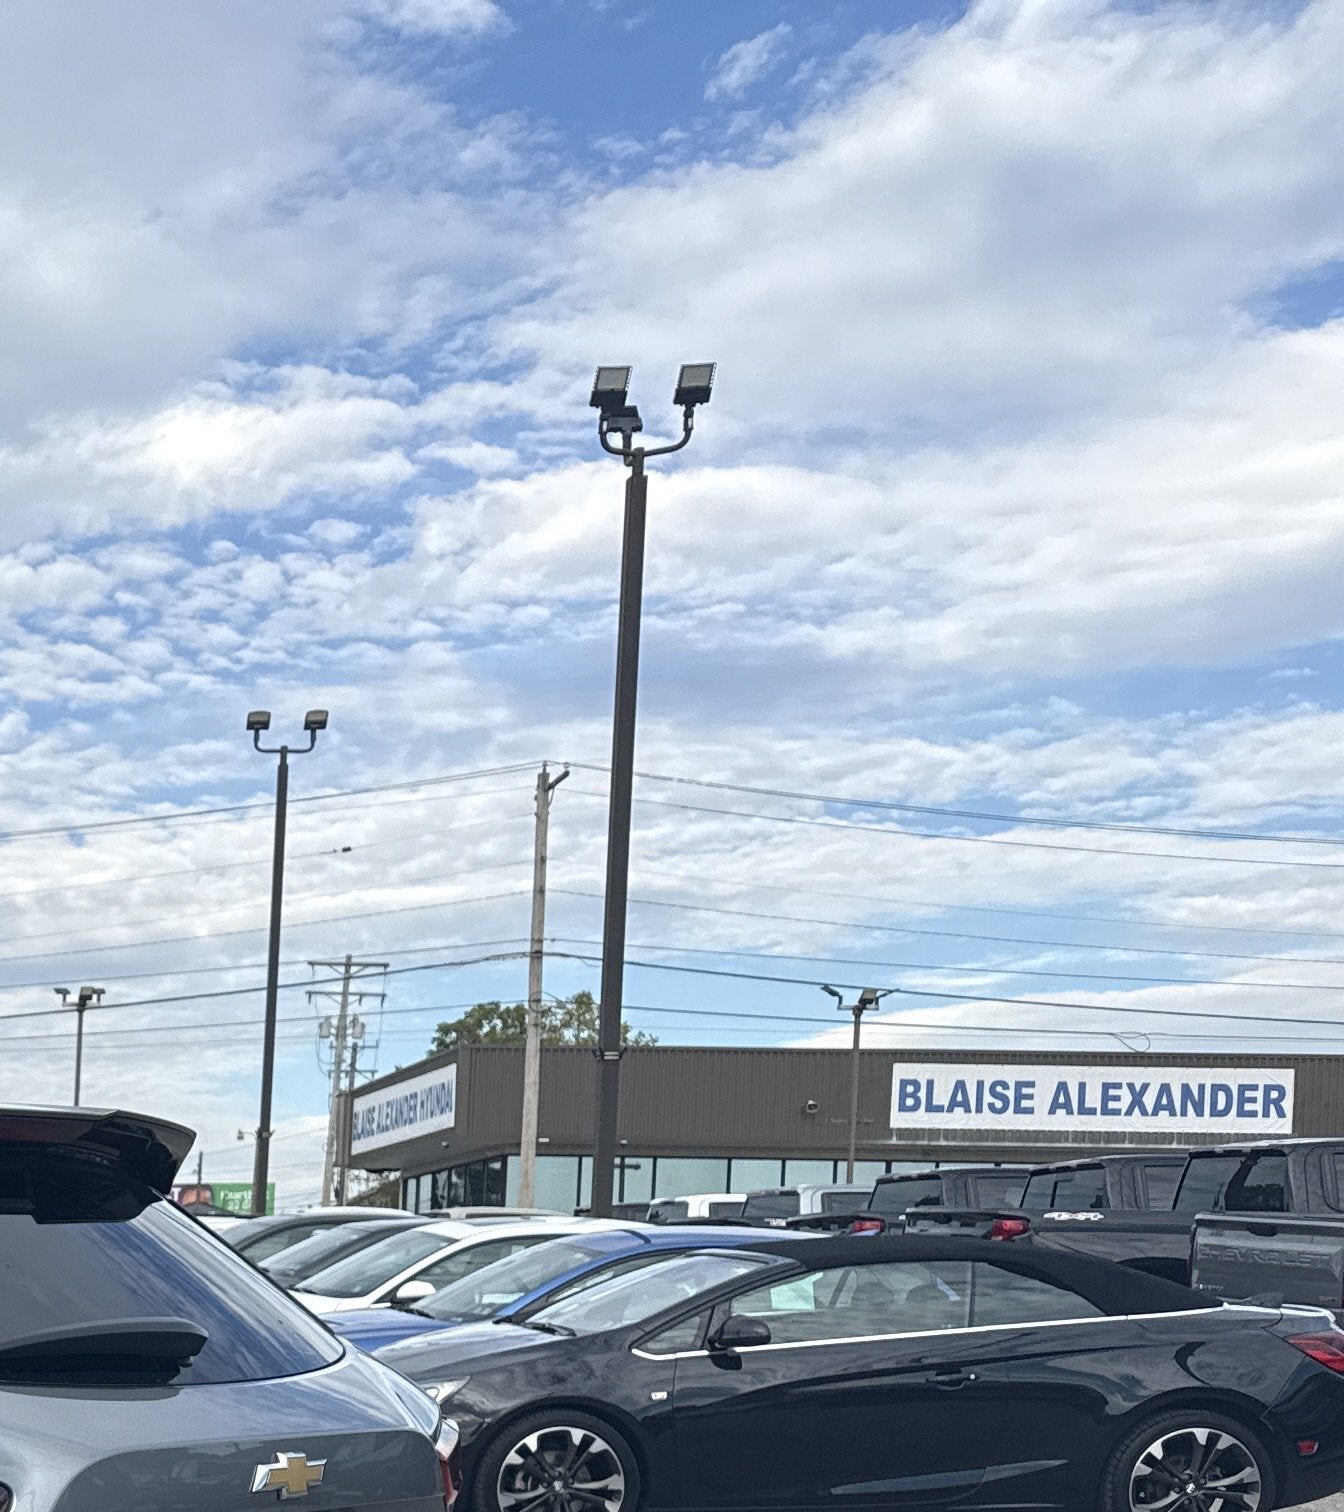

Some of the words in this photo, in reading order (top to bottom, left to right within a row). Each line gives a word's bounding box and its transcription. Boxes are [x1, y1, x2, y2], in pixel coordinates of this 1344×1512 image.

[352, 1105, 375, 1141] BLAISE
[376, 1091, 418, 1134] ALEXANDER
[419, 1079, 453, 1121] HYUNDAI
[898, 1079, 1036, 1114] BLAISE
[1048, 1081, 1287, 1119] ALEXANDER
[1198, 1245, 1331, 1268] CHEVROLET
